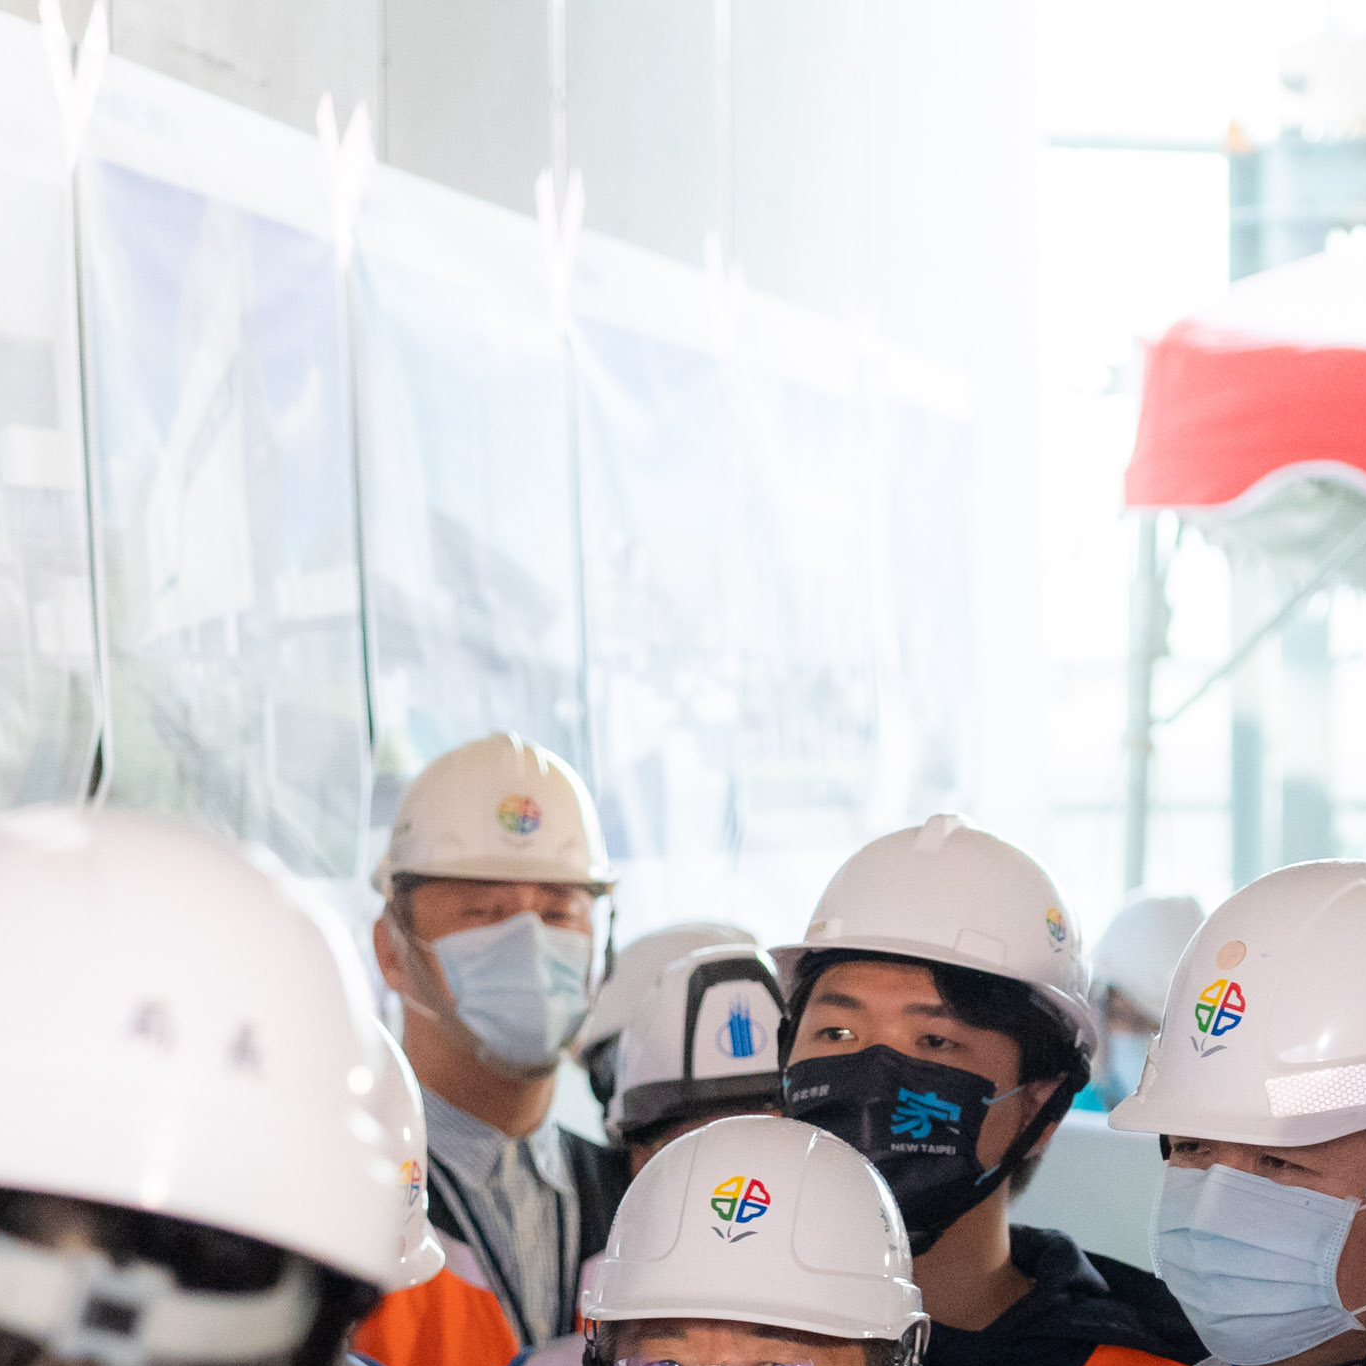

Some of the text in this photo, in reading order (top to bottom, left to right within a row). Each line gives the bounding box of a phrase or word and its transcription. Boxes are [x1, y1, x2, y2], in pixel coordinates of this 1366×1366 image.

[891, 1088, 962, 1139] 家
[891, 1142, 957, 1155] NEW TAIPEI
